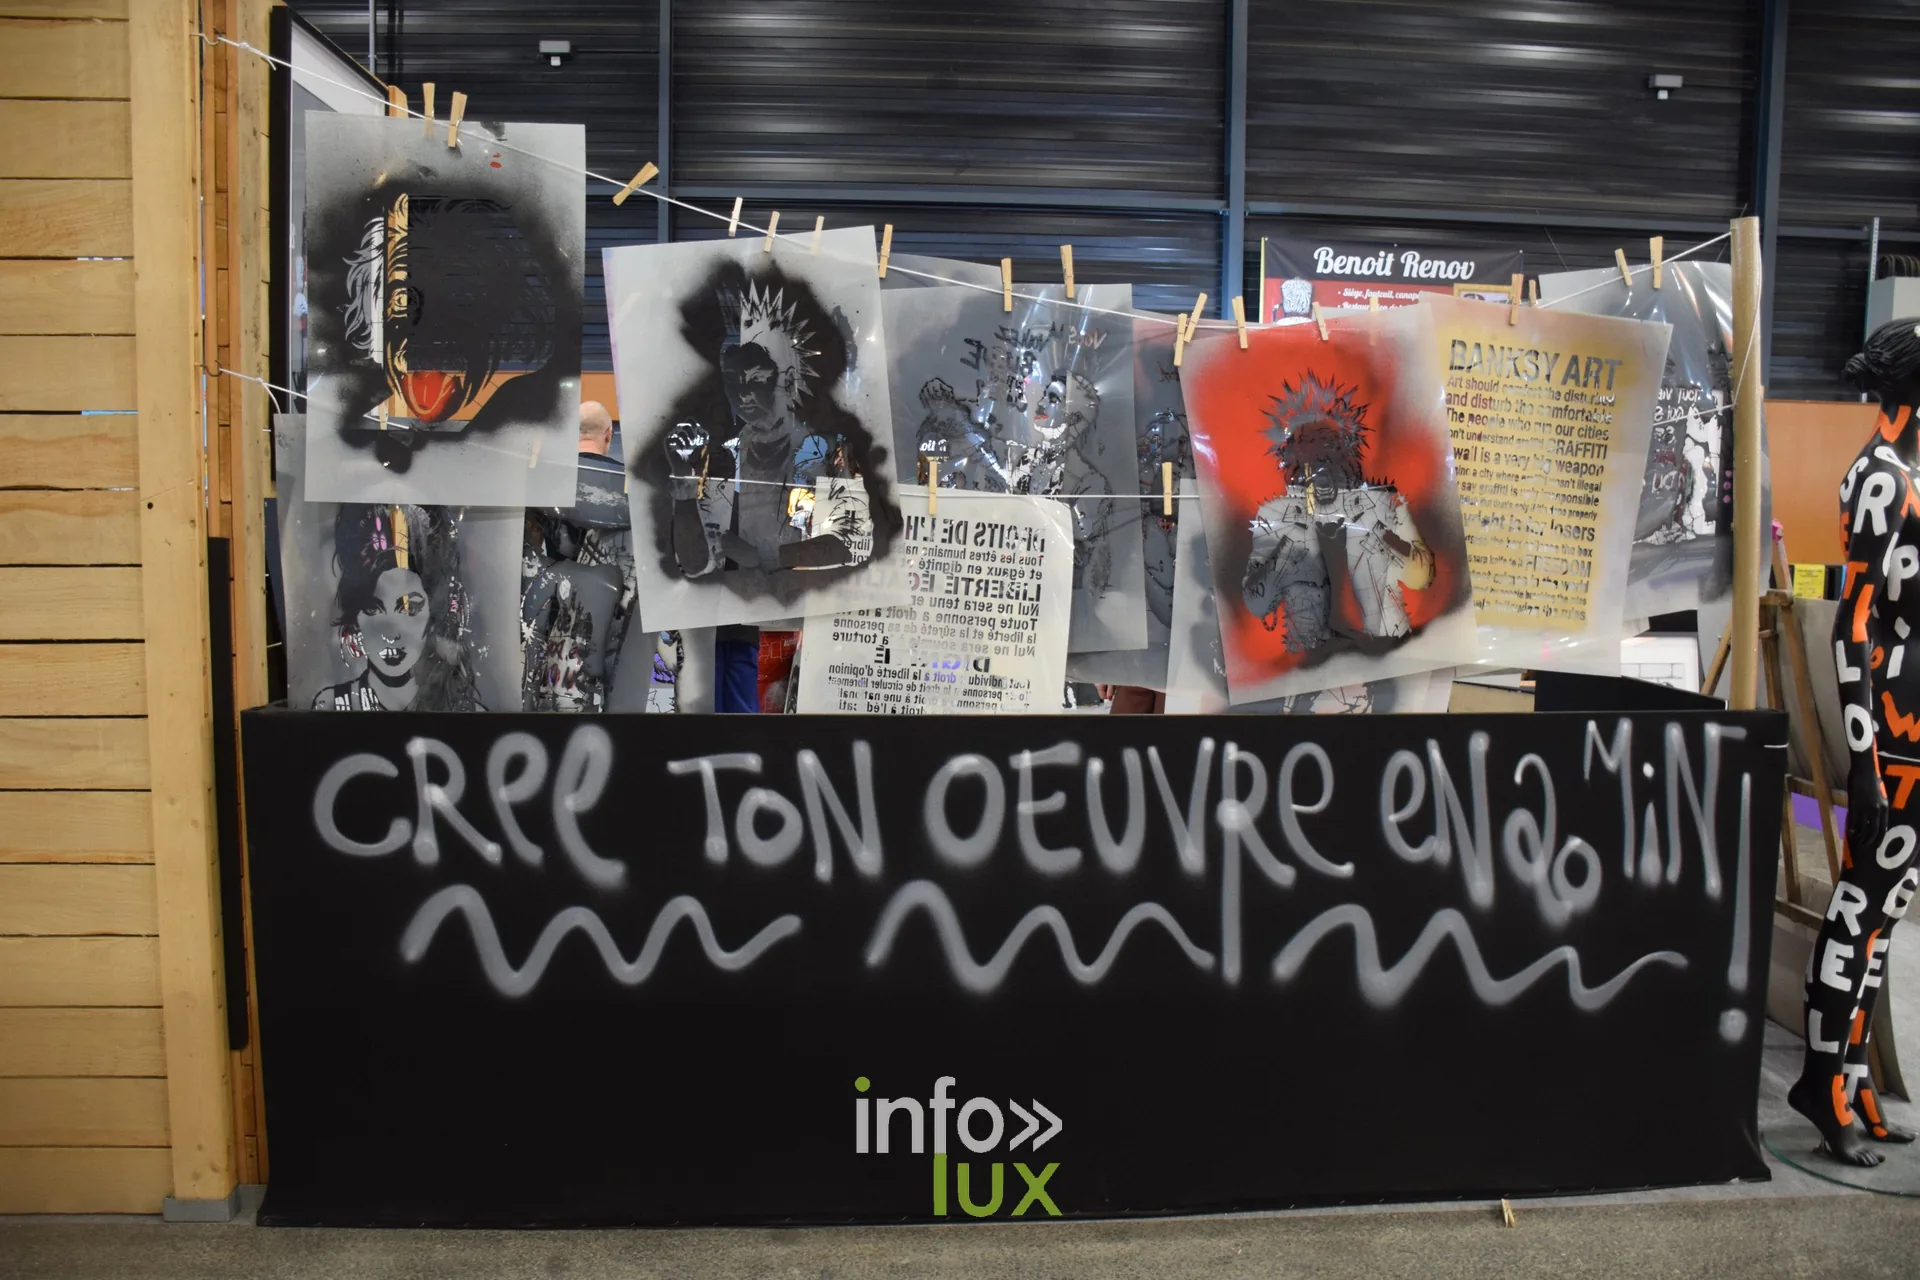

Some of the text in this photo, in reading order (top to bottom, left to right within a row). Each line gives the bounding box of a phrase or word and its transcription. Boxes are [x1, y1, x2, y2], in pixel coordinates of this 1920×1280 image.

[1313, 246, 1475, 280] Benoit Renov
[1449, 339, 1623, 391] BANKSY ART
[1447, 376, 1463, 388] Art
[1465, 377, 1500, 392] should
[1446, 392, 1468, 407] and
[1471, 393, 1512, 412] disturb
[1446, 407, 1465, 423] The
[1555, 424, 1575, 437] our
[1577, 425, 1609, 441] cities
[1449, 428, 1464, 439] on't
[1466, 431, 1514, 444] understand
[1547, 438, 1608, 460] GRAFFITI
[1481, 447, 1491, 463] is
[1494, 452, 1501, 464] a
[1555, 459, 1605, 478] weapon
[1510, 485, 1519, 496] is
[1577, 479, 1603, 493] illegal
[1568, 508, 1598, 521] properly
[1853, 471, 1896, 536] R
